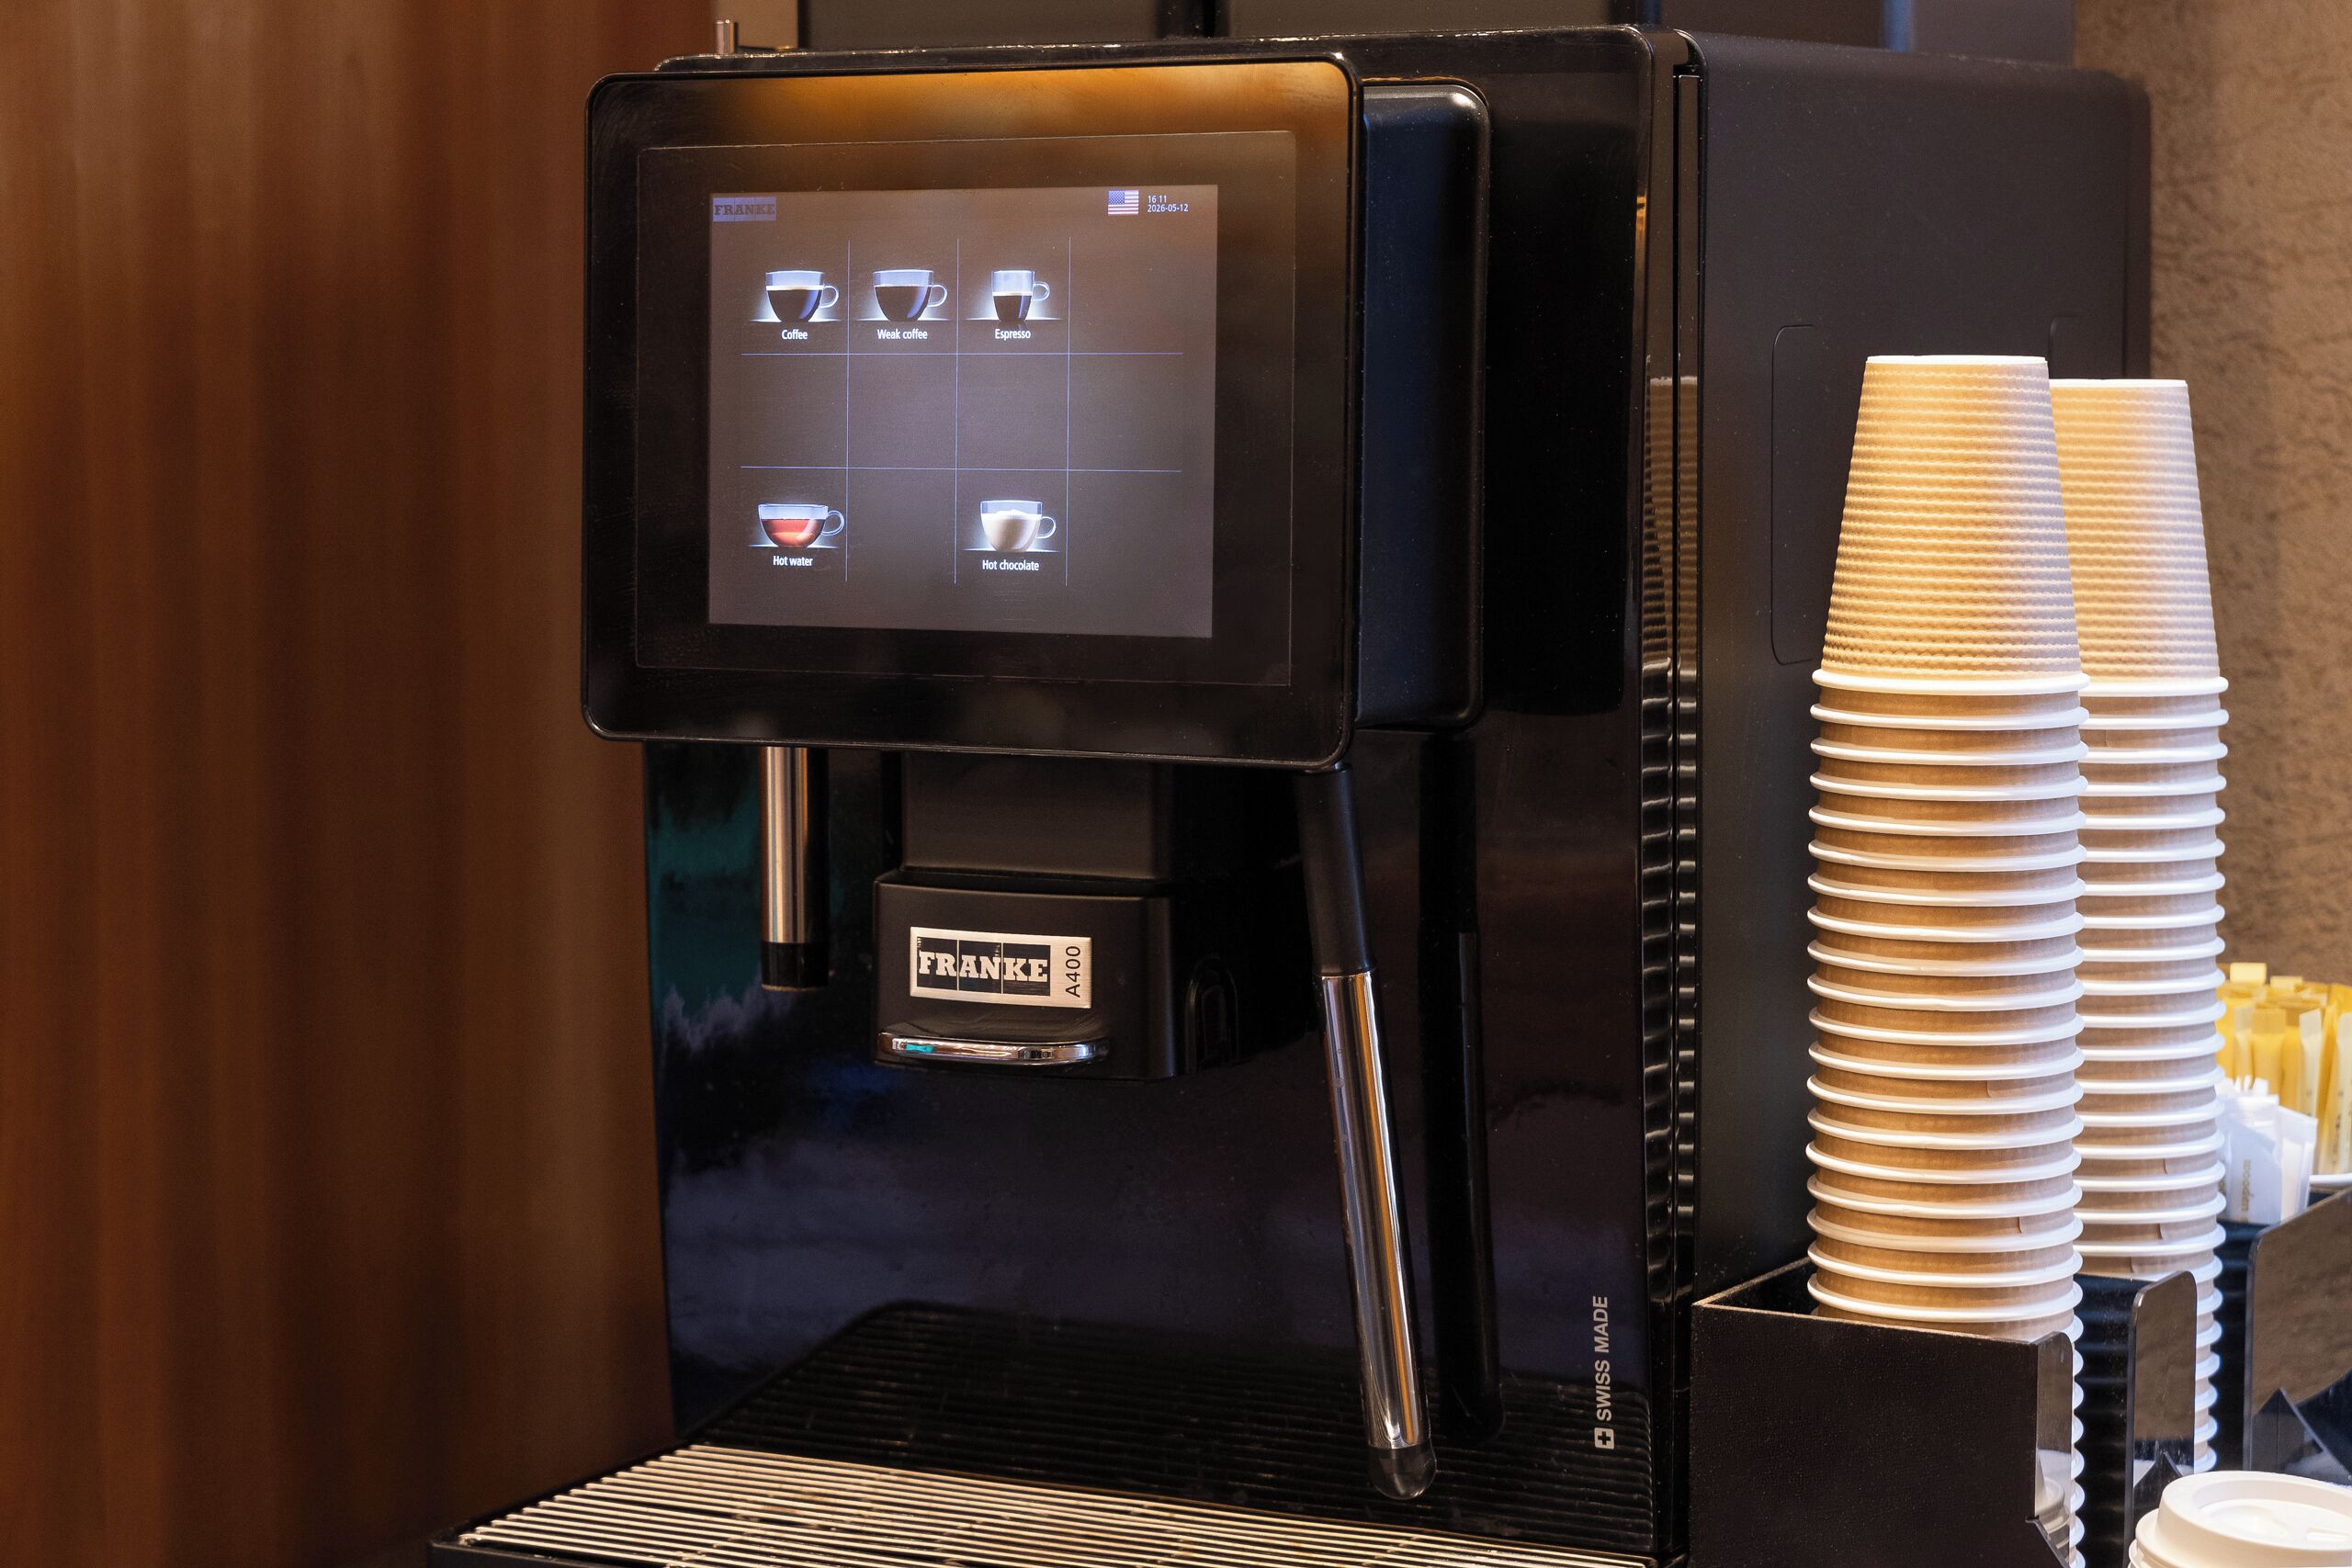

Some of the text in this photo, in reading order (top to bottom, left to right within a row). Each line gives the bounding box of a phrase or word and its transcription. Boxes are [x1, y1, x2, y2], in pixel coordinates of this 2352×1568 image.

[1148, 195, 1157, 204] 16
[1147, 203, 1189, 213] 2026-05-12
[781, 328, 808, 340] Coffee
[876, 328, 928, 340] Weak coffee
[994, 328, 1031, 342] Espresso
[773, 556, 813, 567] Hot water
[982, 559, 1039, 571] Hot chocolate
[918, 950, 1048, 983] FRANKE
[1065, 945, 1081, 998] A400
[1592, 1295, 1612, 1422] SWISS MADE
